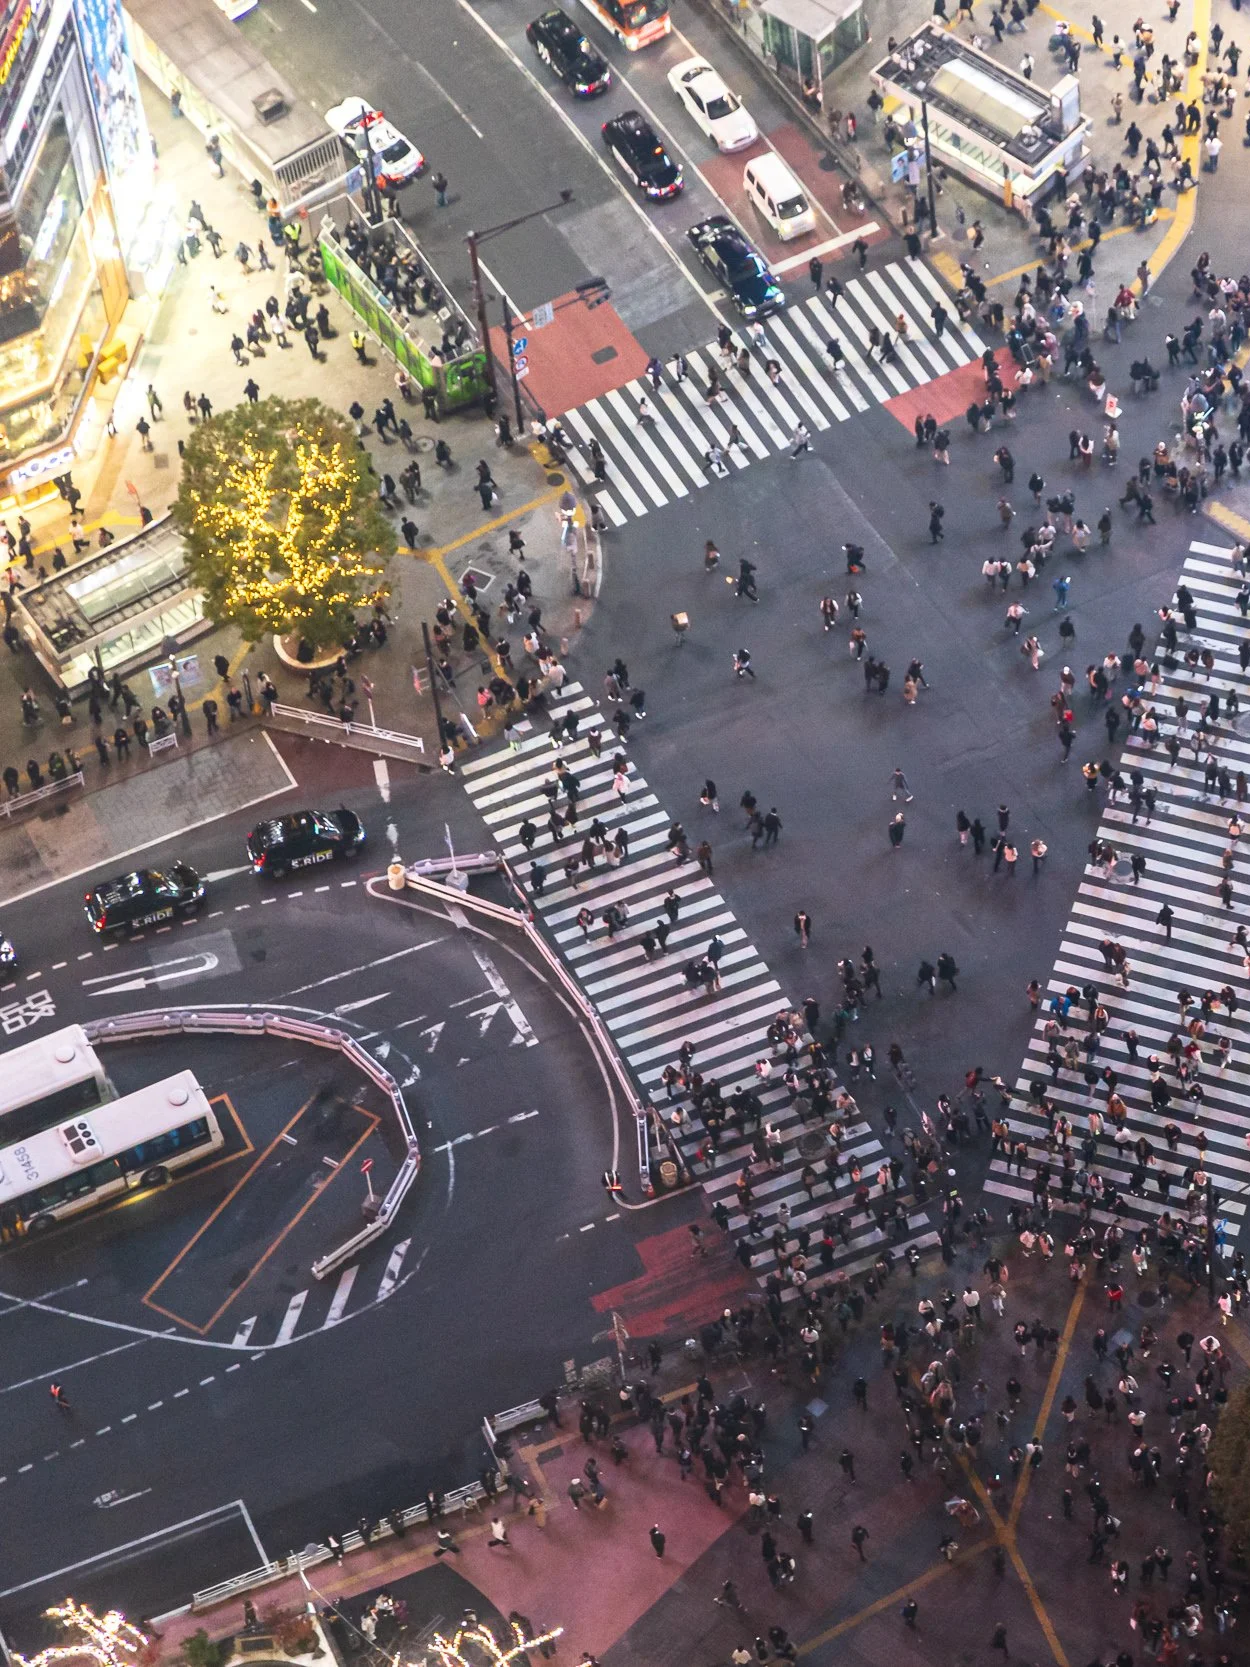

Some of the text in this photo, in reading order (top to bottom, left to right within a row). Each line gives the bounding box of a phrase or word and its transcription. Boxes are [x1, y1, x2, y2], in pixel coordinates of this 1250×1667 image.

[291, 851, 333, 870] S.RIDE
[0, 989, 56, 1035] 路
[14, 1146, 39, 1181] 31458
